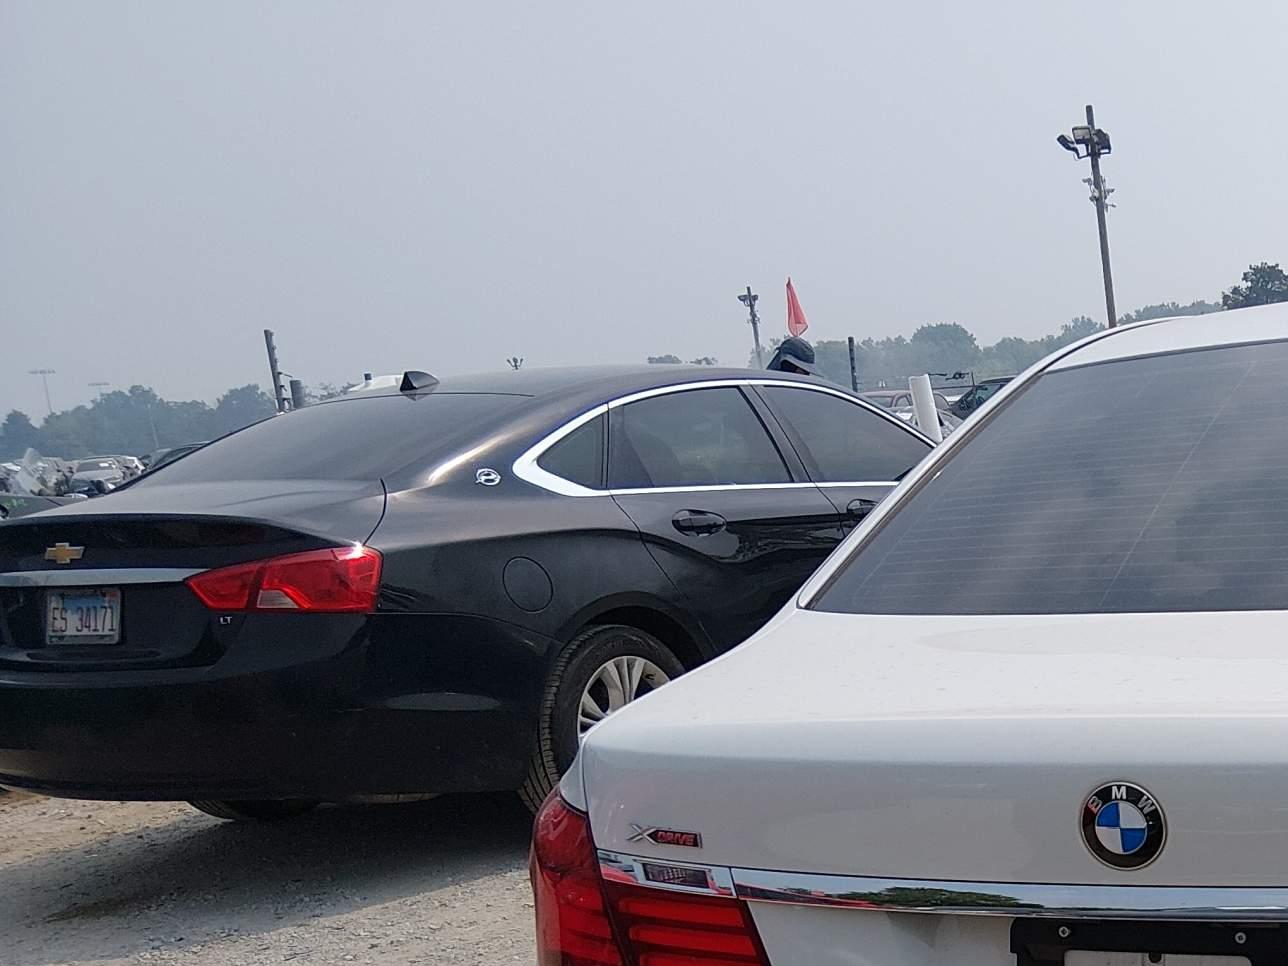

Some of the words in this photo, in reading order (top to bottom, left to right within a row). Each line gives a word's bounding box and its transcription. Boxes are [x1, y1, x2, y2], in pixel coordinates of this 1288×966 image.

[76, 605, 116, 633] 34171
[219, 616, 233, 625] LT
[1087, 785, 1156, 814] BMW
